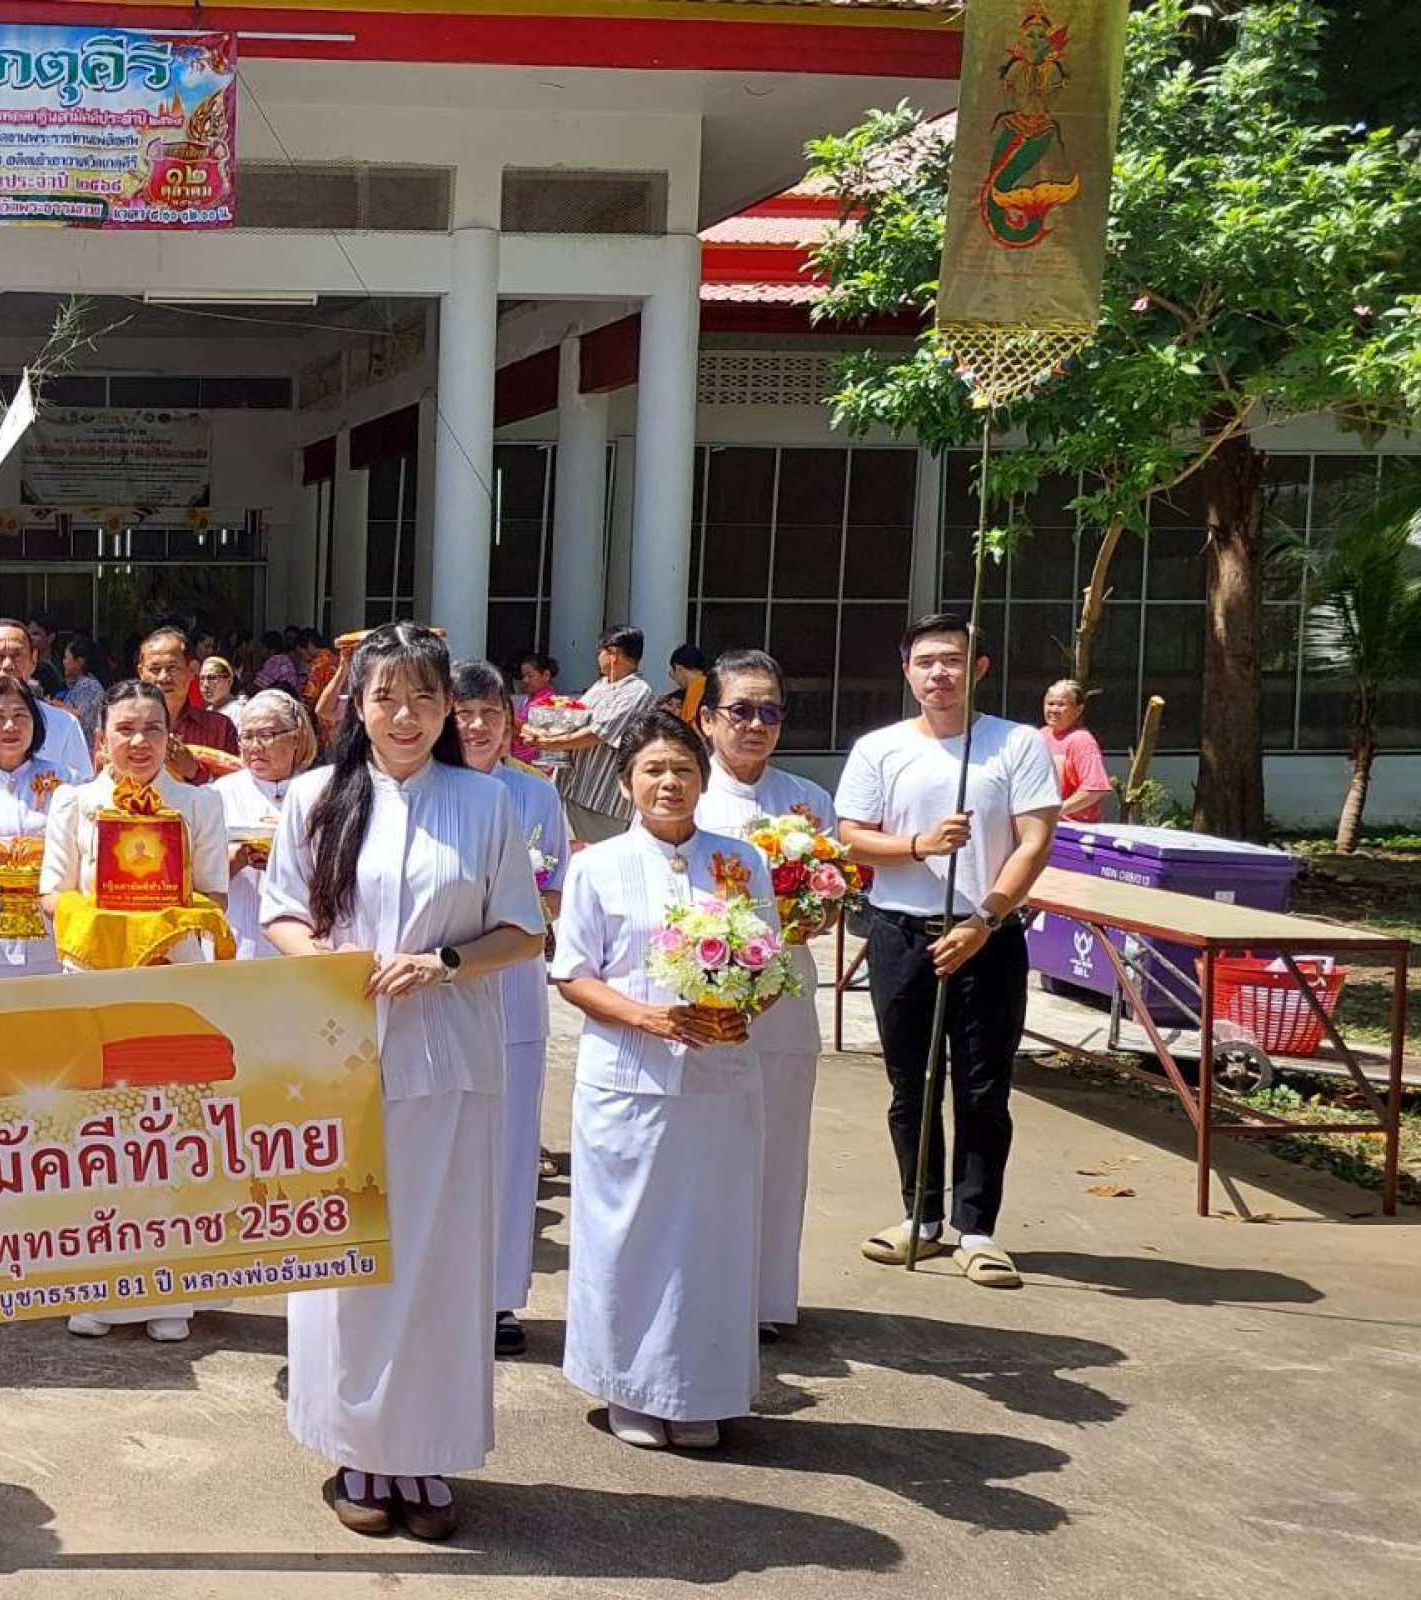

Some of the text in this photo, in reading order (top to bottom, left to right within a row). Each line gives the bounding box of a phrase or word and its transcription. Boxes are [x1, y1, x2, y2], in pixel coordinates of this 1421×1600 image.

[166, 164, 207, 184] ๑๒
[240, 1198, 348, 1241] 2568
[0, 1281, 108, 1317] บูชาธรรม
[117, 1278, 144, 1296] 81
[154, 1269, 172, 1293] ปี
[182, 1250, 375, 1291] หลวงพ่อธัมมชโย
